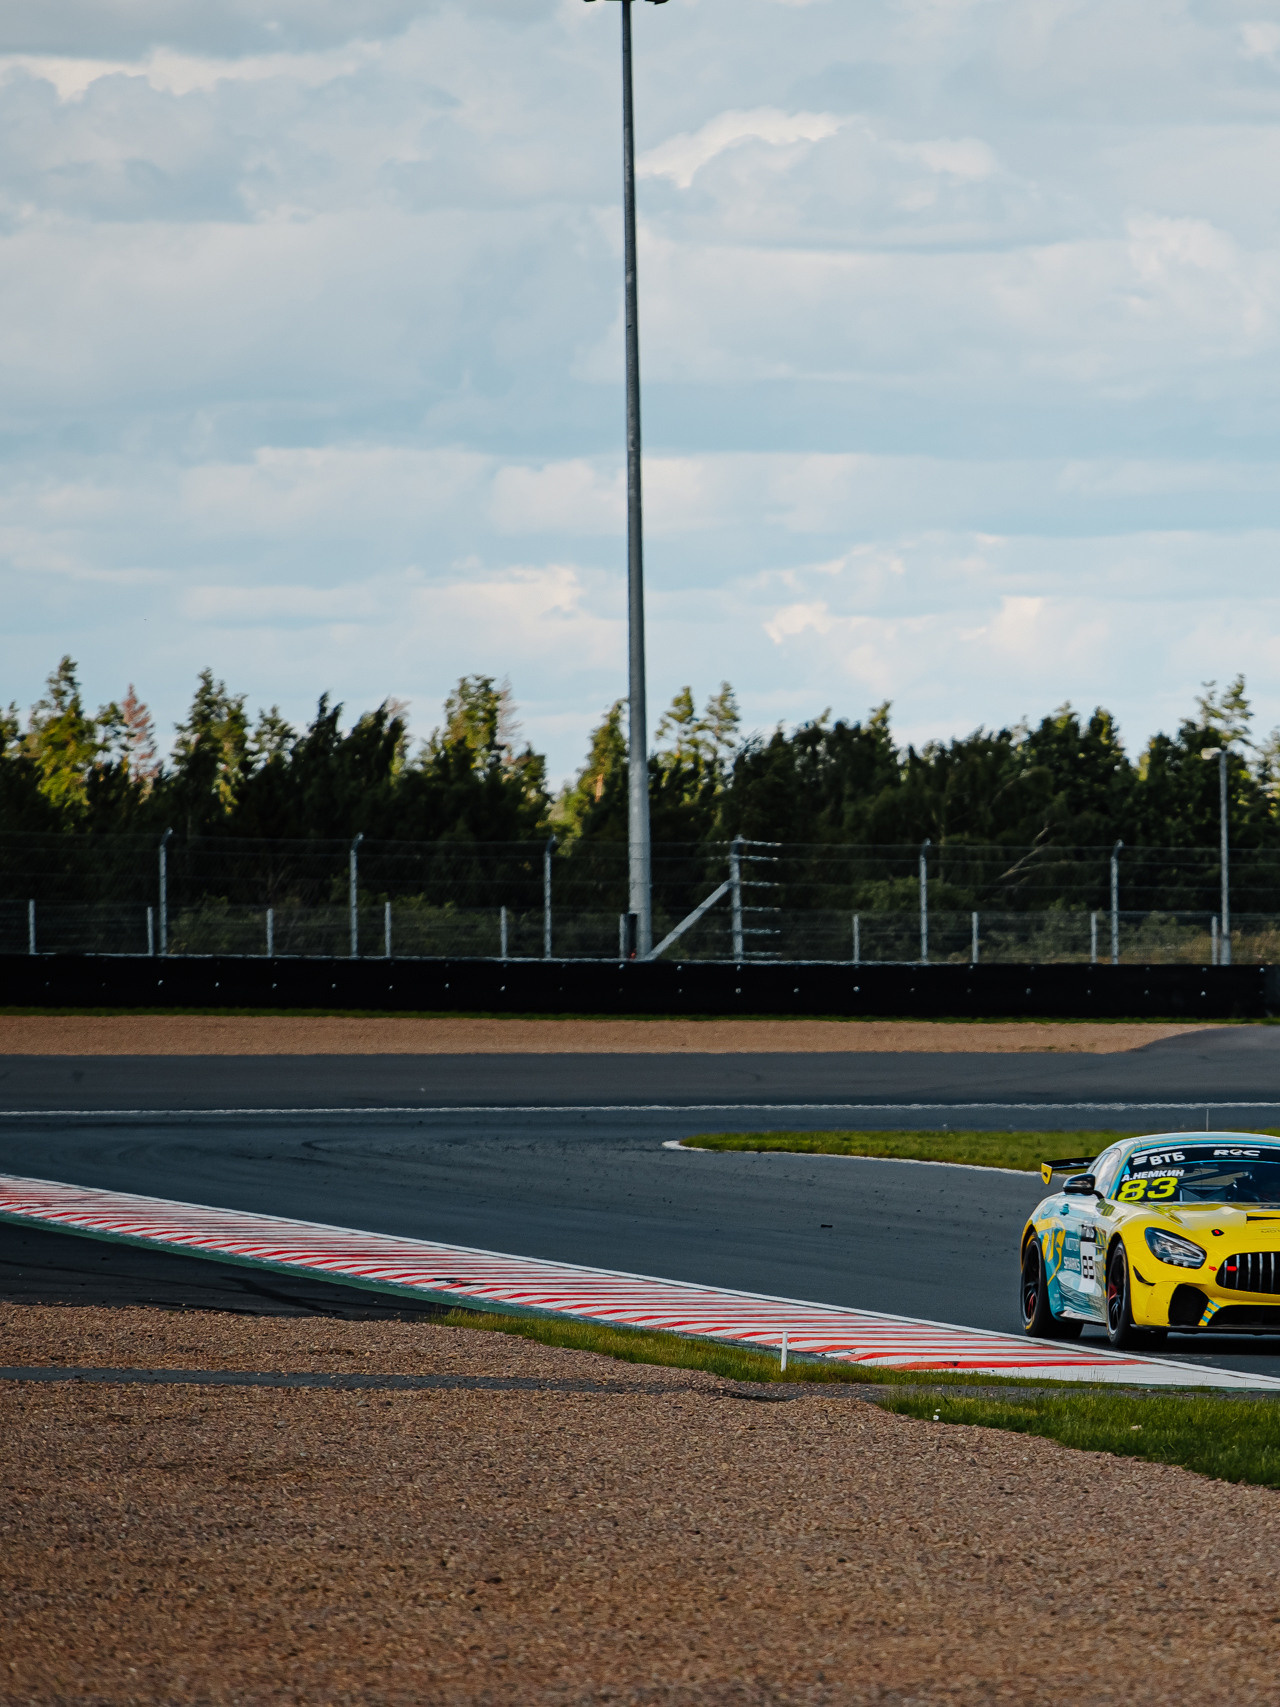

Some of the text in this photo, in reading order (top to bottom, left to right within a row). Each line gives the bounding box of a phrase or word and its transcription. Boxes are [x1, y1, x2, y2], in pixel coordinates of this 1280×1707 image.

[1149, 1151, 1186, 1166] ВТБ
[1121, 1169, 1185, 1182] А.НЕМКИН
[1117, 1177, 1179, 1202] 83
